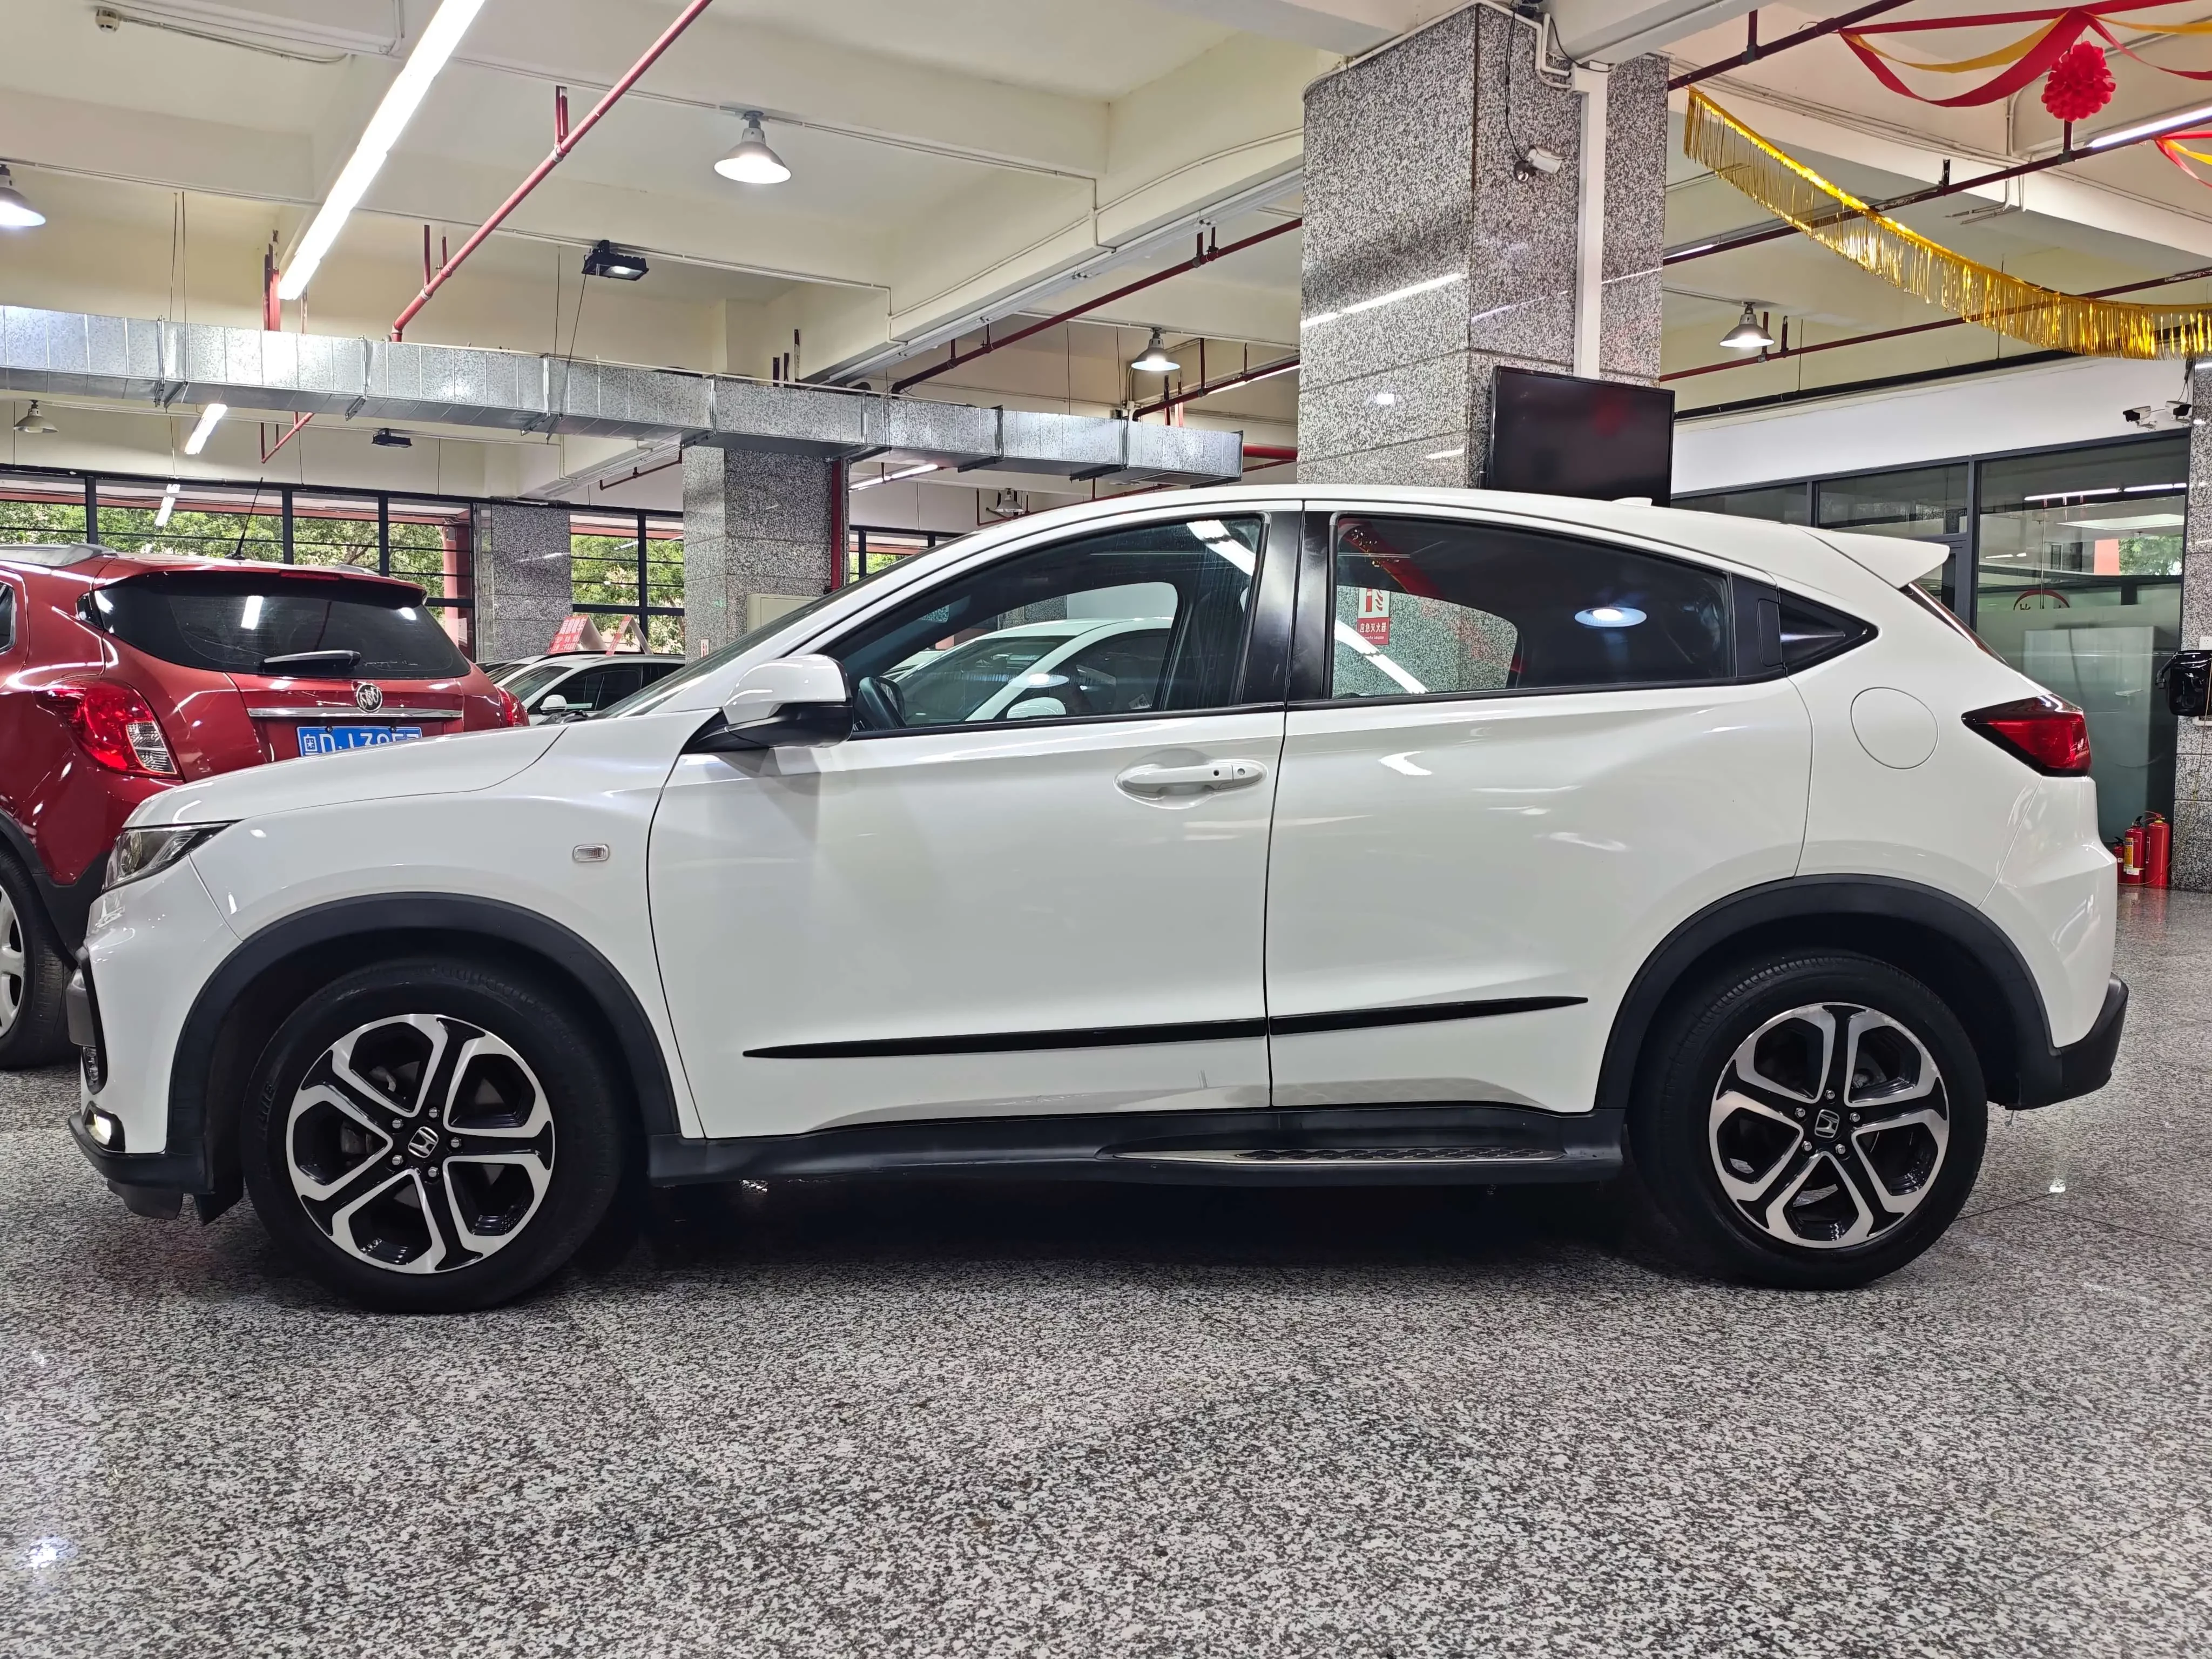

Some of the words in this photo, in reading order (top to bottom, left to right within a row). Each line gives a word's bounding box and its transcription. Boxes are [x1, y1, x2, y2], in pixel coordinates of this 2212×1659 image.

[1360, 622, 1386, 633] 应急灭火器
